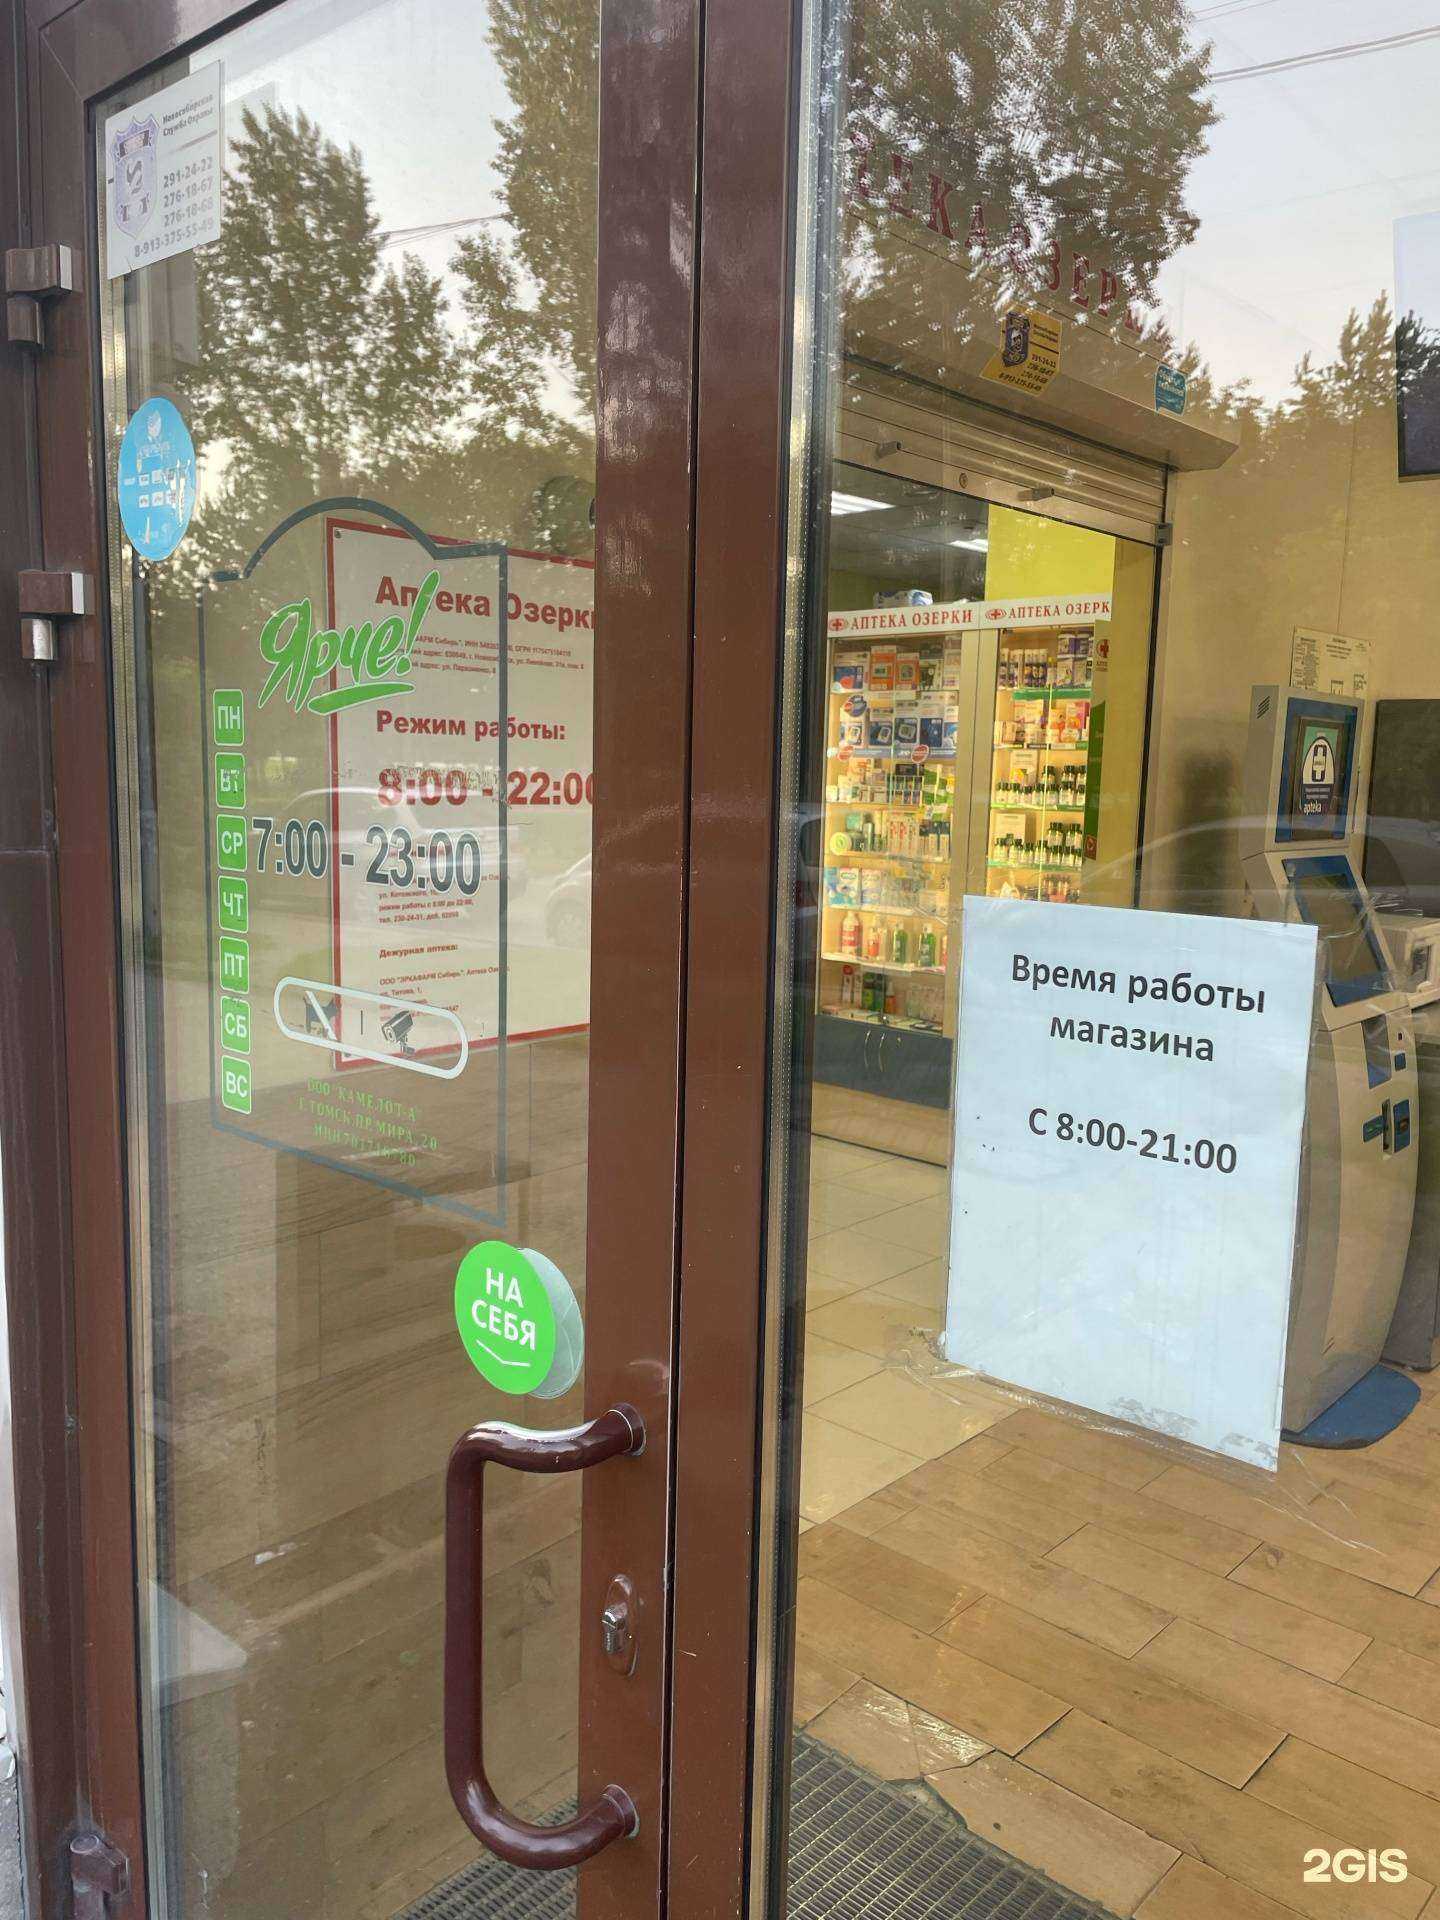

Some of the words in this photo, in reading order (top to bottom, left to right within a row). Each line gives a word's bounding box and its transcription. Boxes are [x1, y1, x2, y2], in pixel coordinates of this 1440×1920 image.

[163, 156, 213, 189] 291-24-22
[375, 575, 490, 617] Апека
[851, 610, 907, 630] АПТЕКА
[912, 609, 973, 626] ОЗЕРКИ
[1009, 604, 1061, 620] АПТЕКА
[258, 570, 440, 712] Ярче!
[217, 705, 241, 731] ПН
[377, 710, 466, 735] Режим
[474, 720, 566, 741] работы:
[220, 831, 244, 855] СР
[253, 817, 328, 879] 7:00
[365, 825, 481, 896] 23:00
[221, 892, 245, 917] ЧТ
[223, 953, 246, 977] ПТ
[379, 945, 425, 959] Дежурная
[1011, 953, 1117, 995] Время
[1128, 973, 1267, 1014] работы
[224, 1014, 248, 1039] СБ
[1050, 1016, 1215, 1062] магазина
[225, 1072, 249, 1098] ВС
[1028, 1109, 1048, 1136] С
[1056, 1112, 1238, 1174] 8:00-21:00
[485, 1267, 524, 1309] НА
[471, 1299, 537, 1352] СЕБЯ
